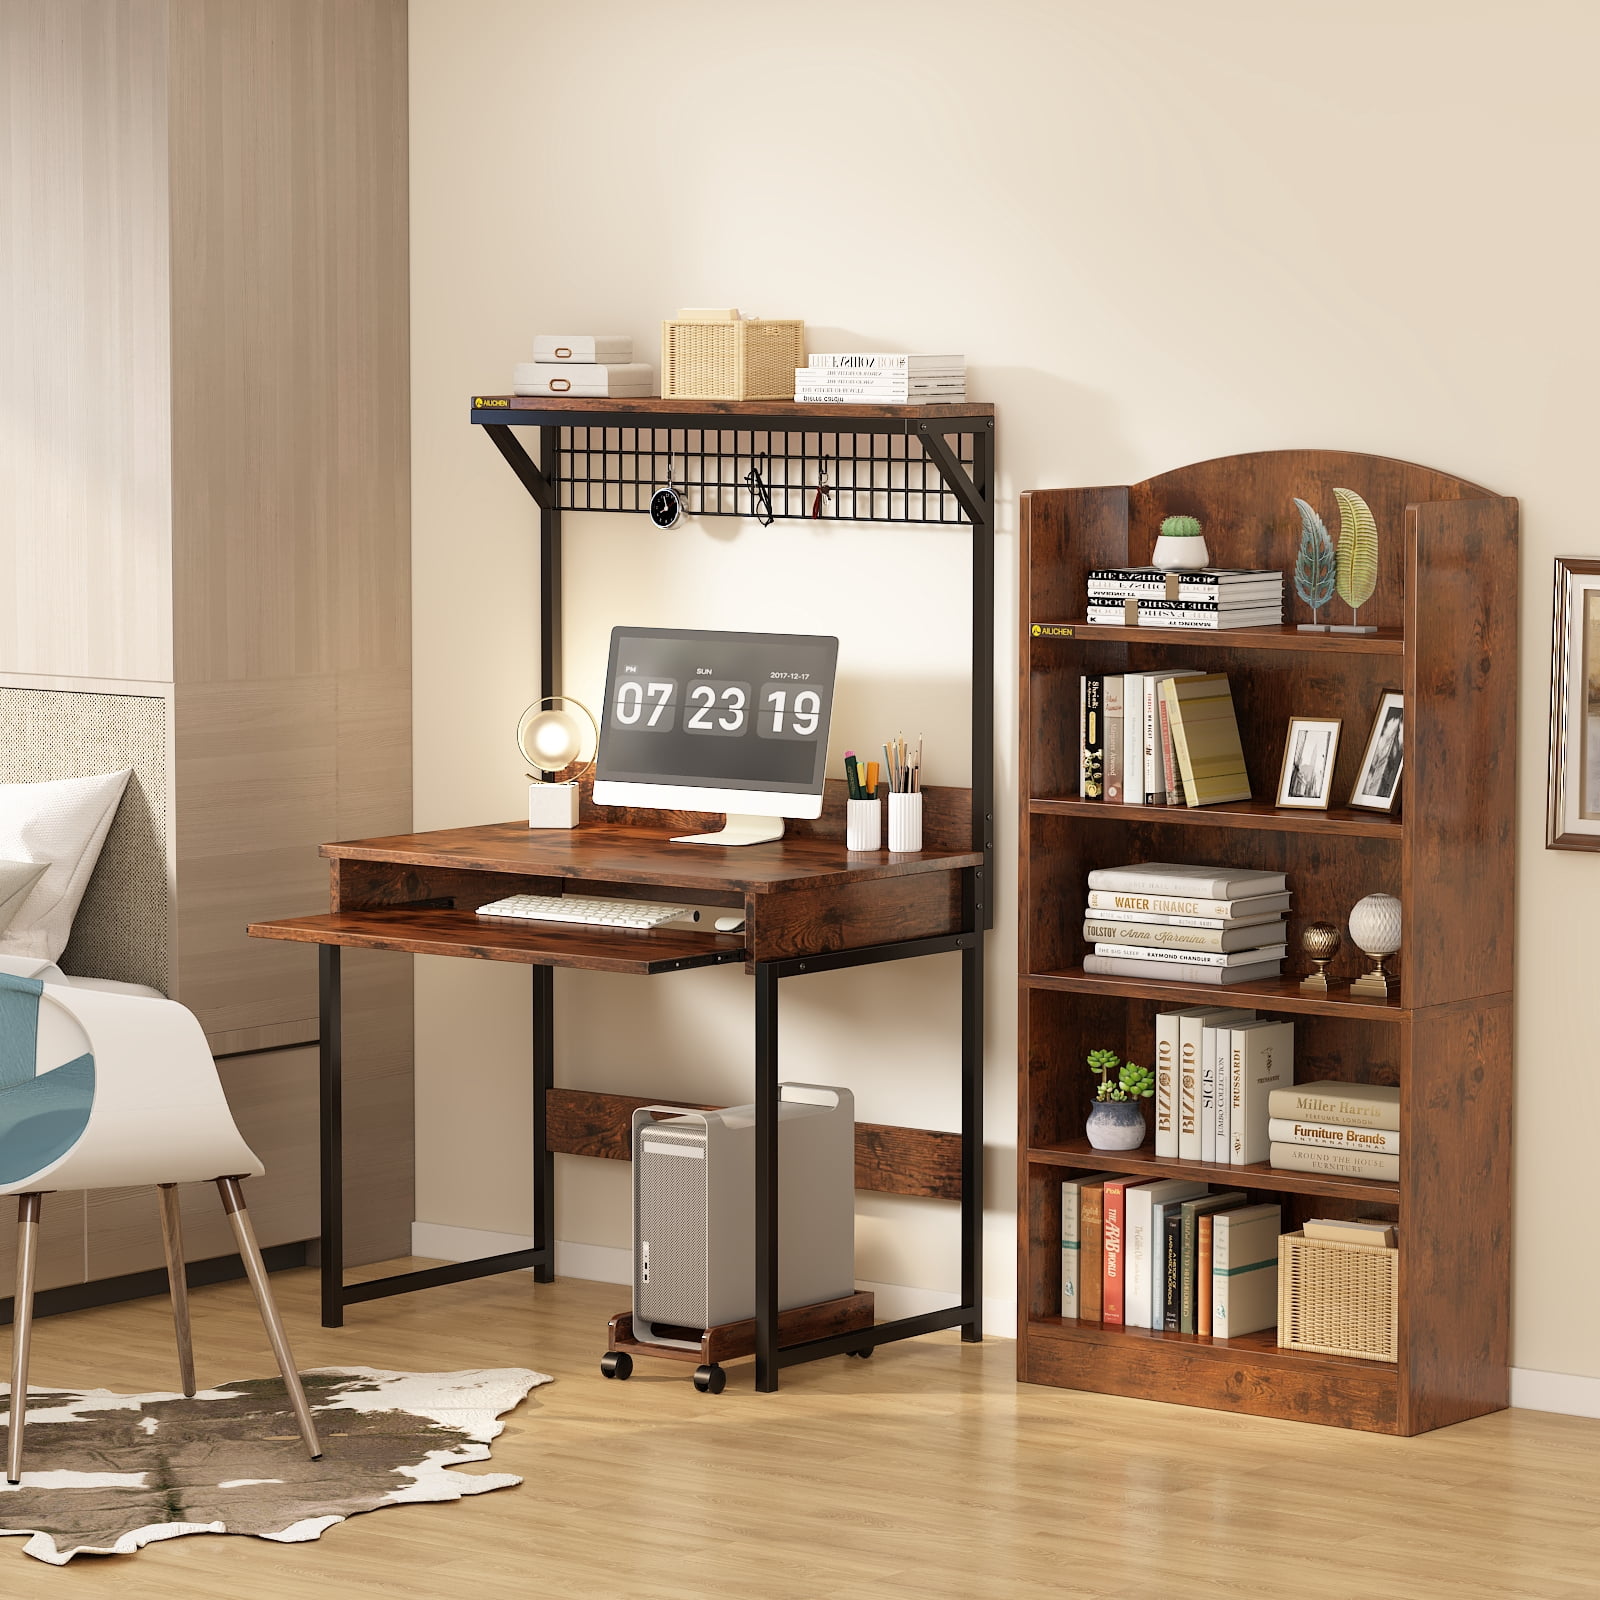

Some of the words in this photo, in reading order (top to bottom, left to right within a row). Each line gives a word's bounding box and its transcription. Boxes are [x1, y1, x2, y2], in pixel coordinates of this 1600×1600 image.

[1138, 600, 1185, 609] FASHIO
[1041, 626, 1073, 636] AILICHEN
[770, 672, 810, 680] 2017-12-17
[616, 681, 674, 727] 07
[688, 685, 746, 731] 23
[768, 690, 821, 736] 19
[1115, 896, 1149, 910] WATER
[1153, 899, 1199, 914] FINANCE
[1087, 925, 1117, 938] TOLSTOY
[1120, 928, 1150, 939] Anna
[1154, 931, 1206, 944] Karenina
[1147, 952, 1178, 960] RAYMOND
[1233, 1049, 1241, 1109] TRUSSARDI
[1203, 1069, 1214, 1109] SICIS
[1296, 1097, 1336, 1112] Miller
[1340, 1101, 1381, 1117] Harris
[1217, 1109, 1225, 1137] JUMBO
[1305, 1113, 1340, 1122] PERFUMER
[1342, 1117, 1373, 1125] LONDON
[1294, 1124, 1344, 1140] Furniture
[1346, 1130, 1386, 1145] Brands
[1294, 1137, 1386, 1150] INTERNATIONAL
[1291, 1151, 1330, 1161] AROUND
[1332, 1155, 1350, 1164] THE
[1353, 1158, 1385, 1168] HOUSE
[1312, 1161, 1363, 1172] FURNITURE
[1108, 1208, 1117, 1224] THE
[1105, 1218, 1120, 1253] ARAB
[1107, 1251, 1117, 1278] WORLD
